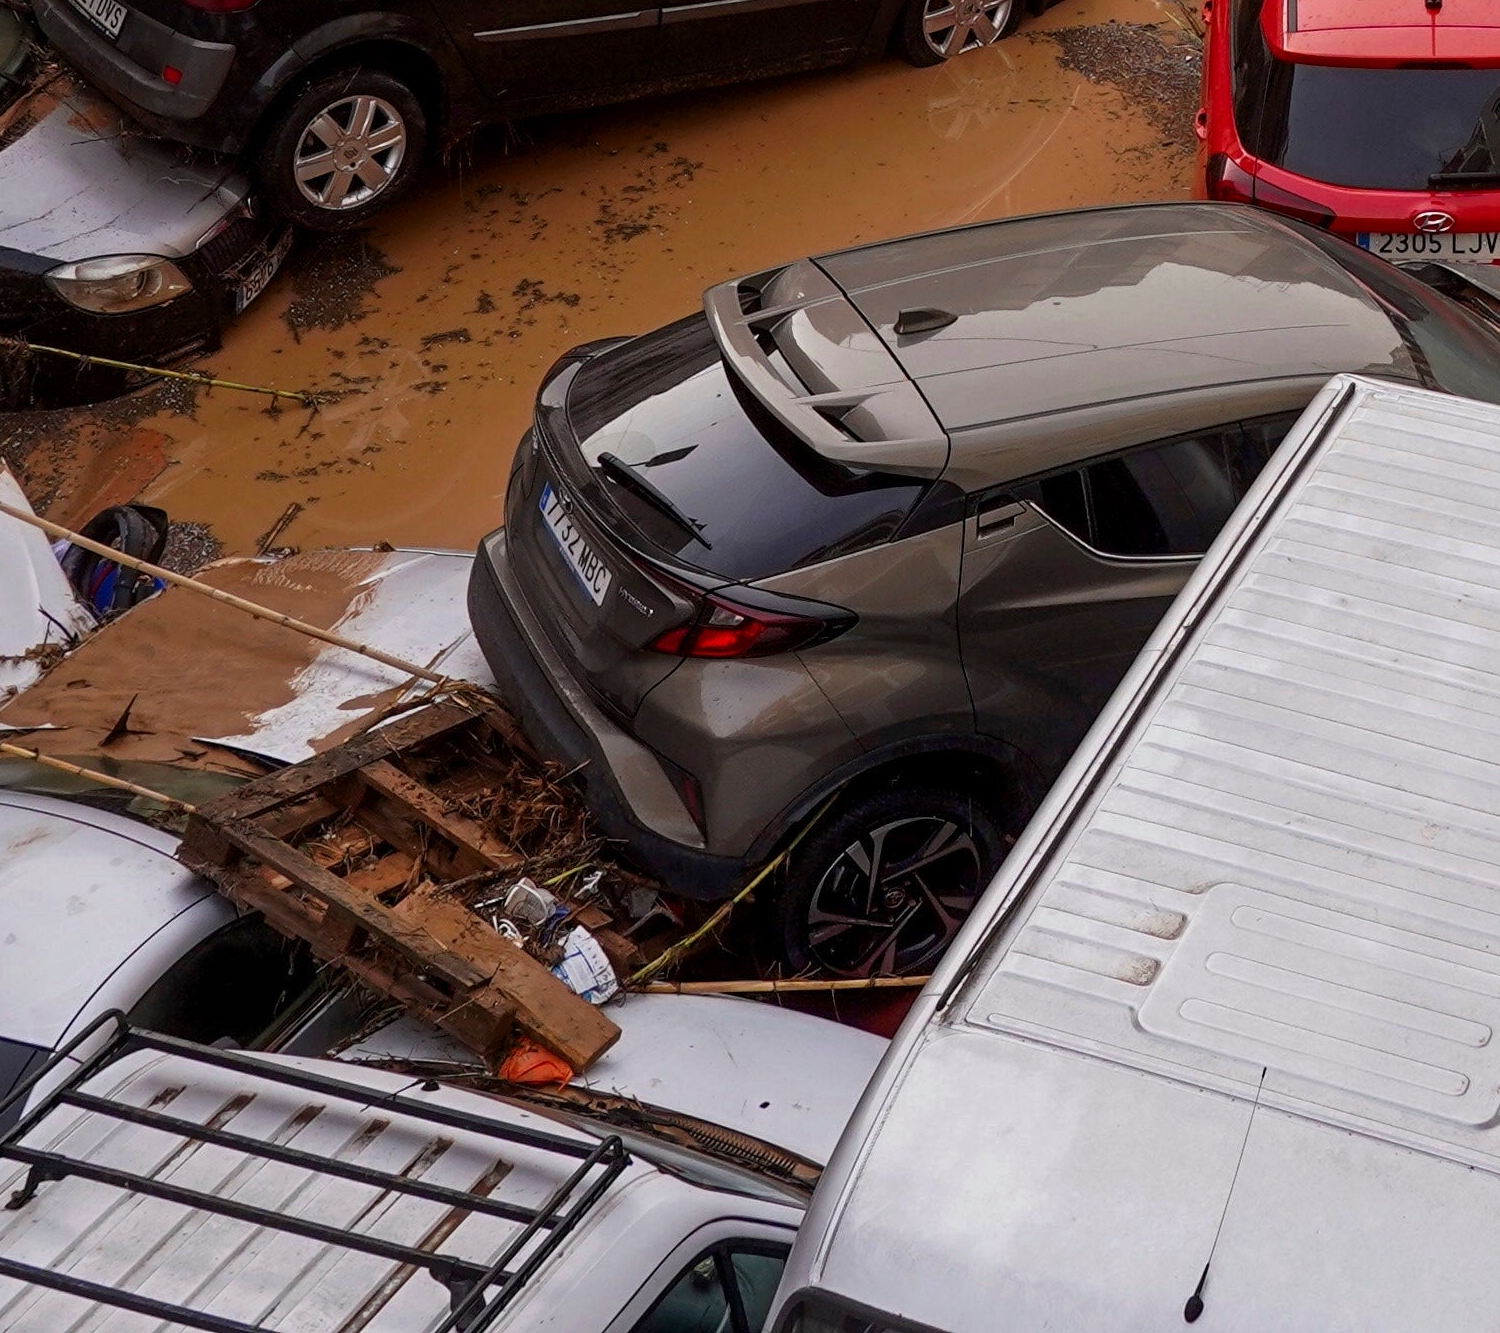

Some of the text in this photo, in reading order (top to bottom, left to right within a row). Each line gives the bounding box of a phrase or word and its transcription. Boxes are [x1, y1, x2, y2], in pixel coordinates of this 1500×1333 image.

[1379, 233, 1500, 254] 2305 LJV
[577, 545, 607, 595] MBC
